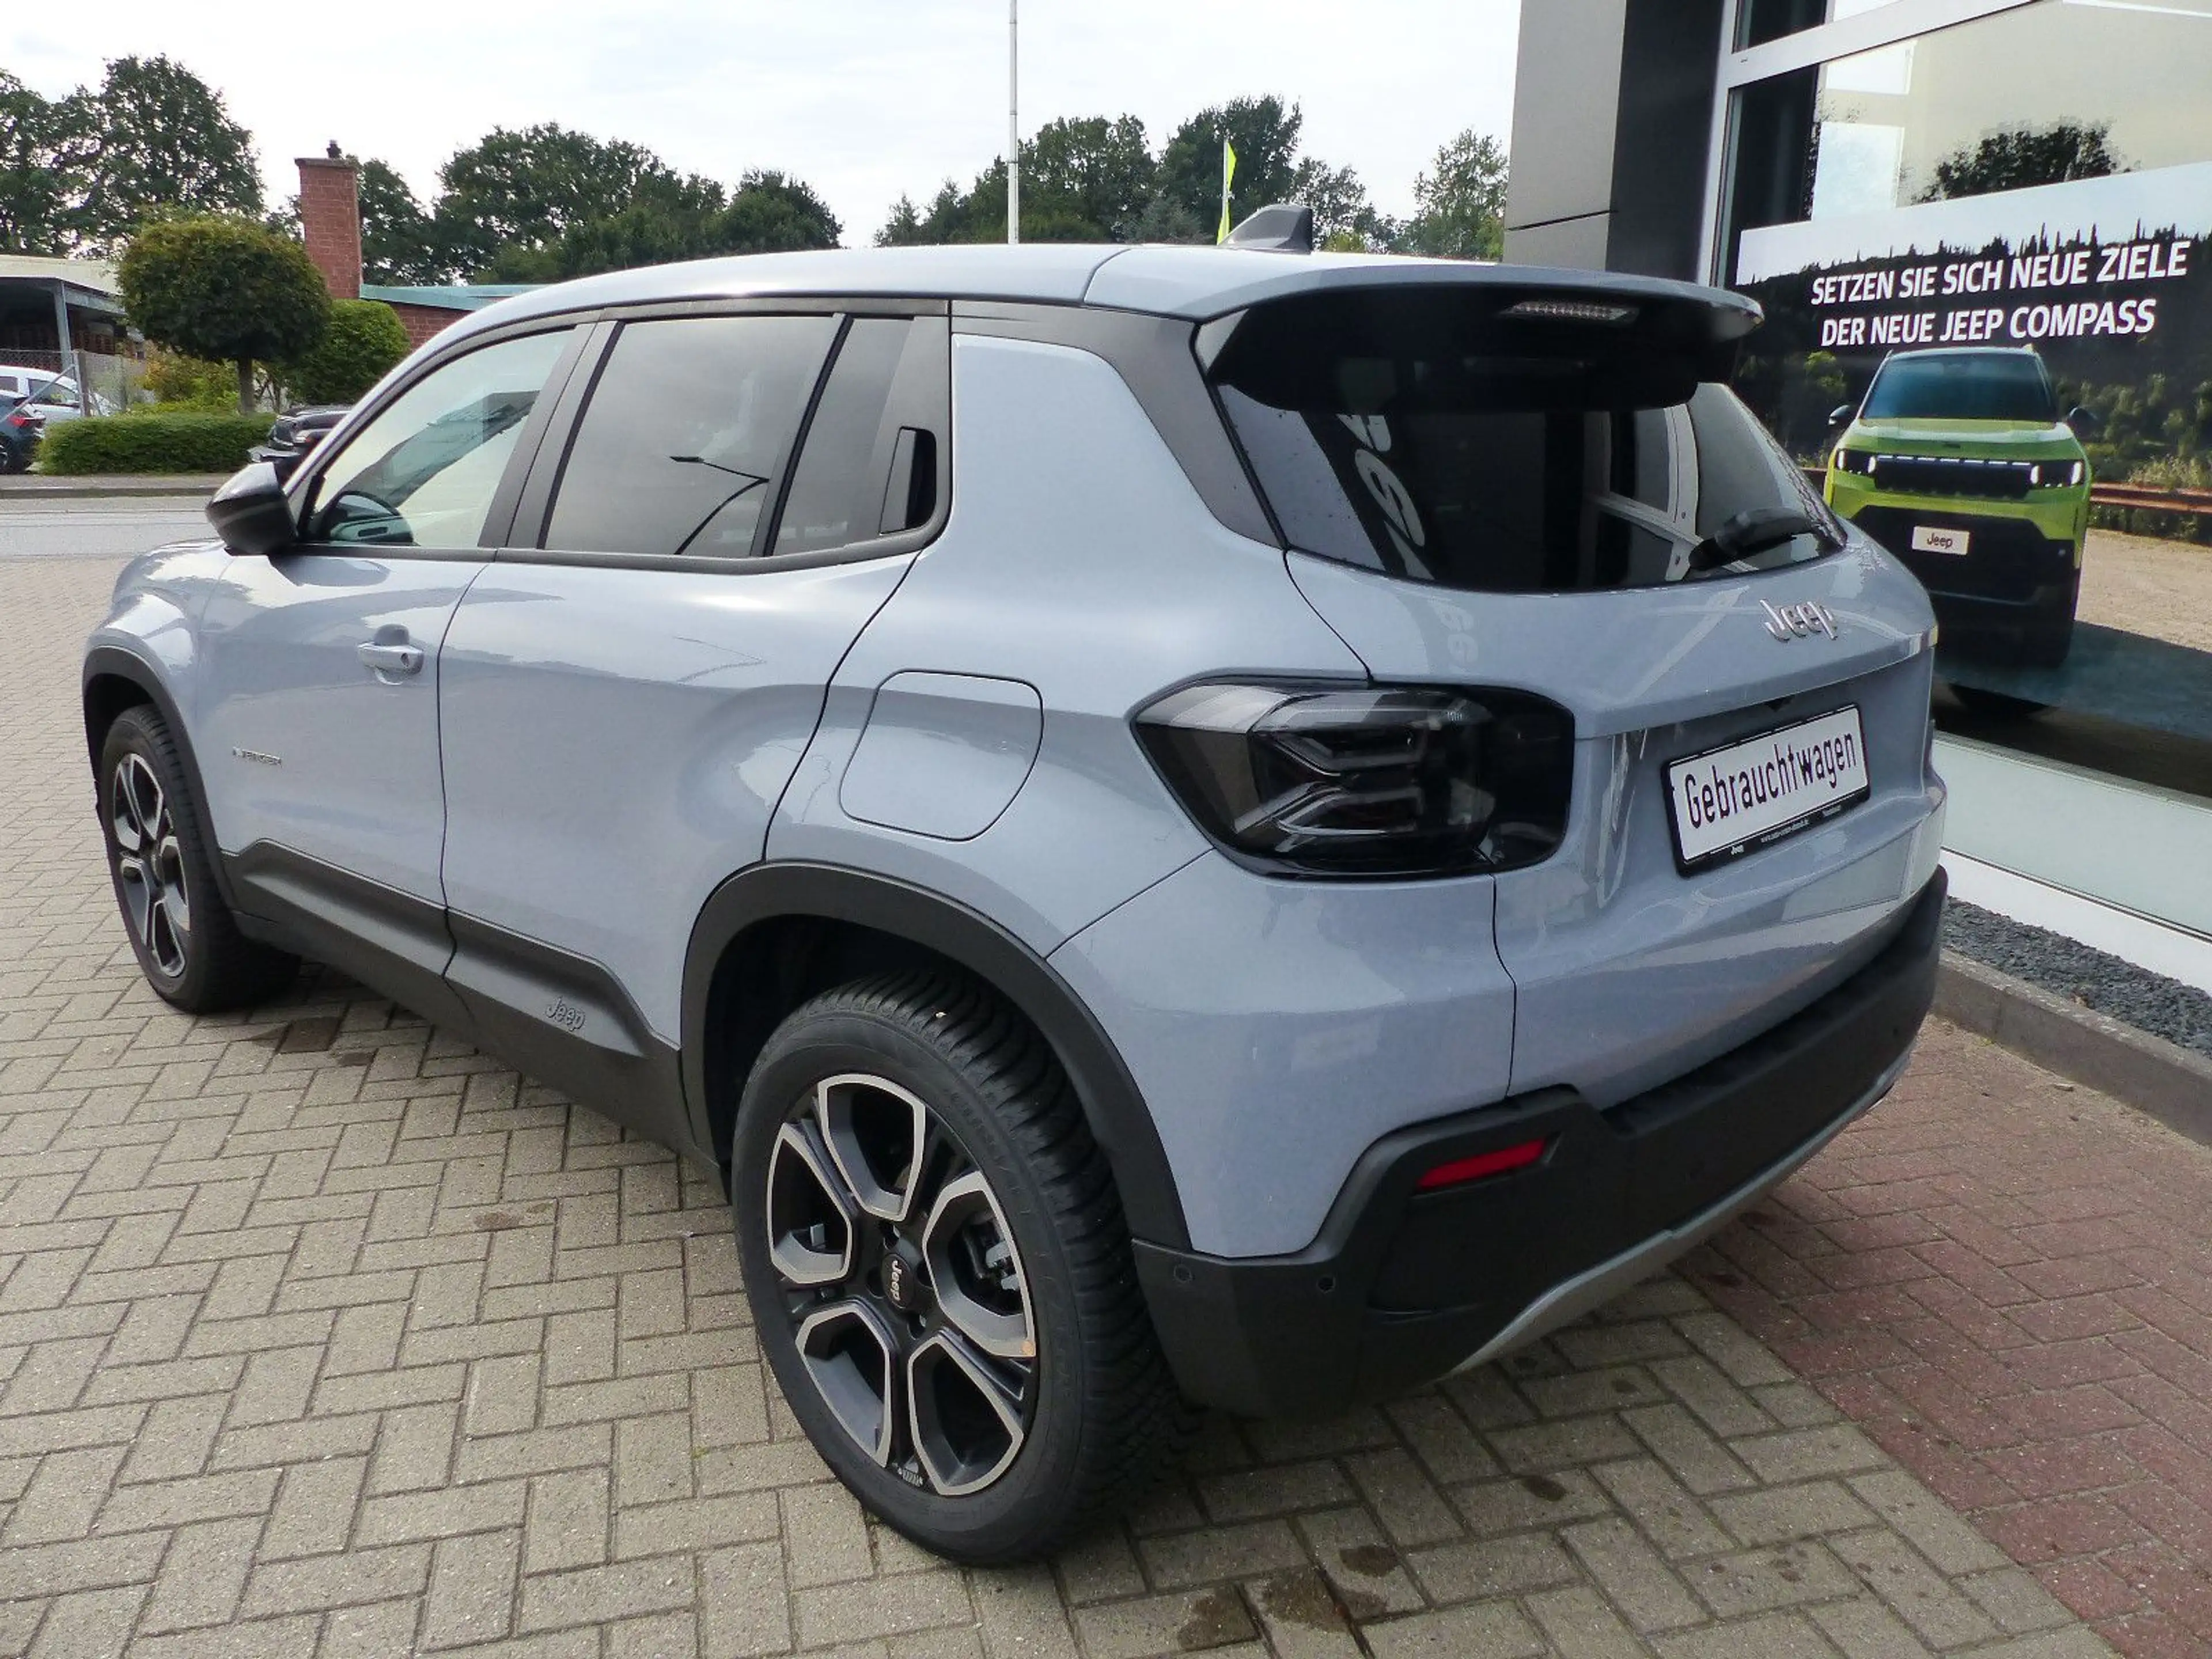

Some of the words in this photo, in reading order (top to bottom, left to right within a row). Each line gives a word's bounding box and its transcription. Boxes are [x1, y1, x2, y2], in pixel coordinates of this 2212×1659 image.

[1810, 270, 1895, 305] SETZEN
[1899, 266, 1938, 299] SIE
[1941, 259, 2004, 295] SICH
[2009, 251, 2091, 289] NEUE
[2096, 240, 2191, 283] ZIELE
[1820, 317, 1866, 346] DER
[1870, 312, 1936, 345] NEUE
[1938, 309, 2005, 342] JEEP
[2009, 298, 2157, 339] COMPASS
[1927, 532, 1953, 550] Jeep
[1759, 598, 1838, 642] Jeep
[1684, 732, 1857, 830] Gebrauchtwagen
[544, 996, 586, 1033] Jeep
[890, 1260, 903, 1301] Jeep
